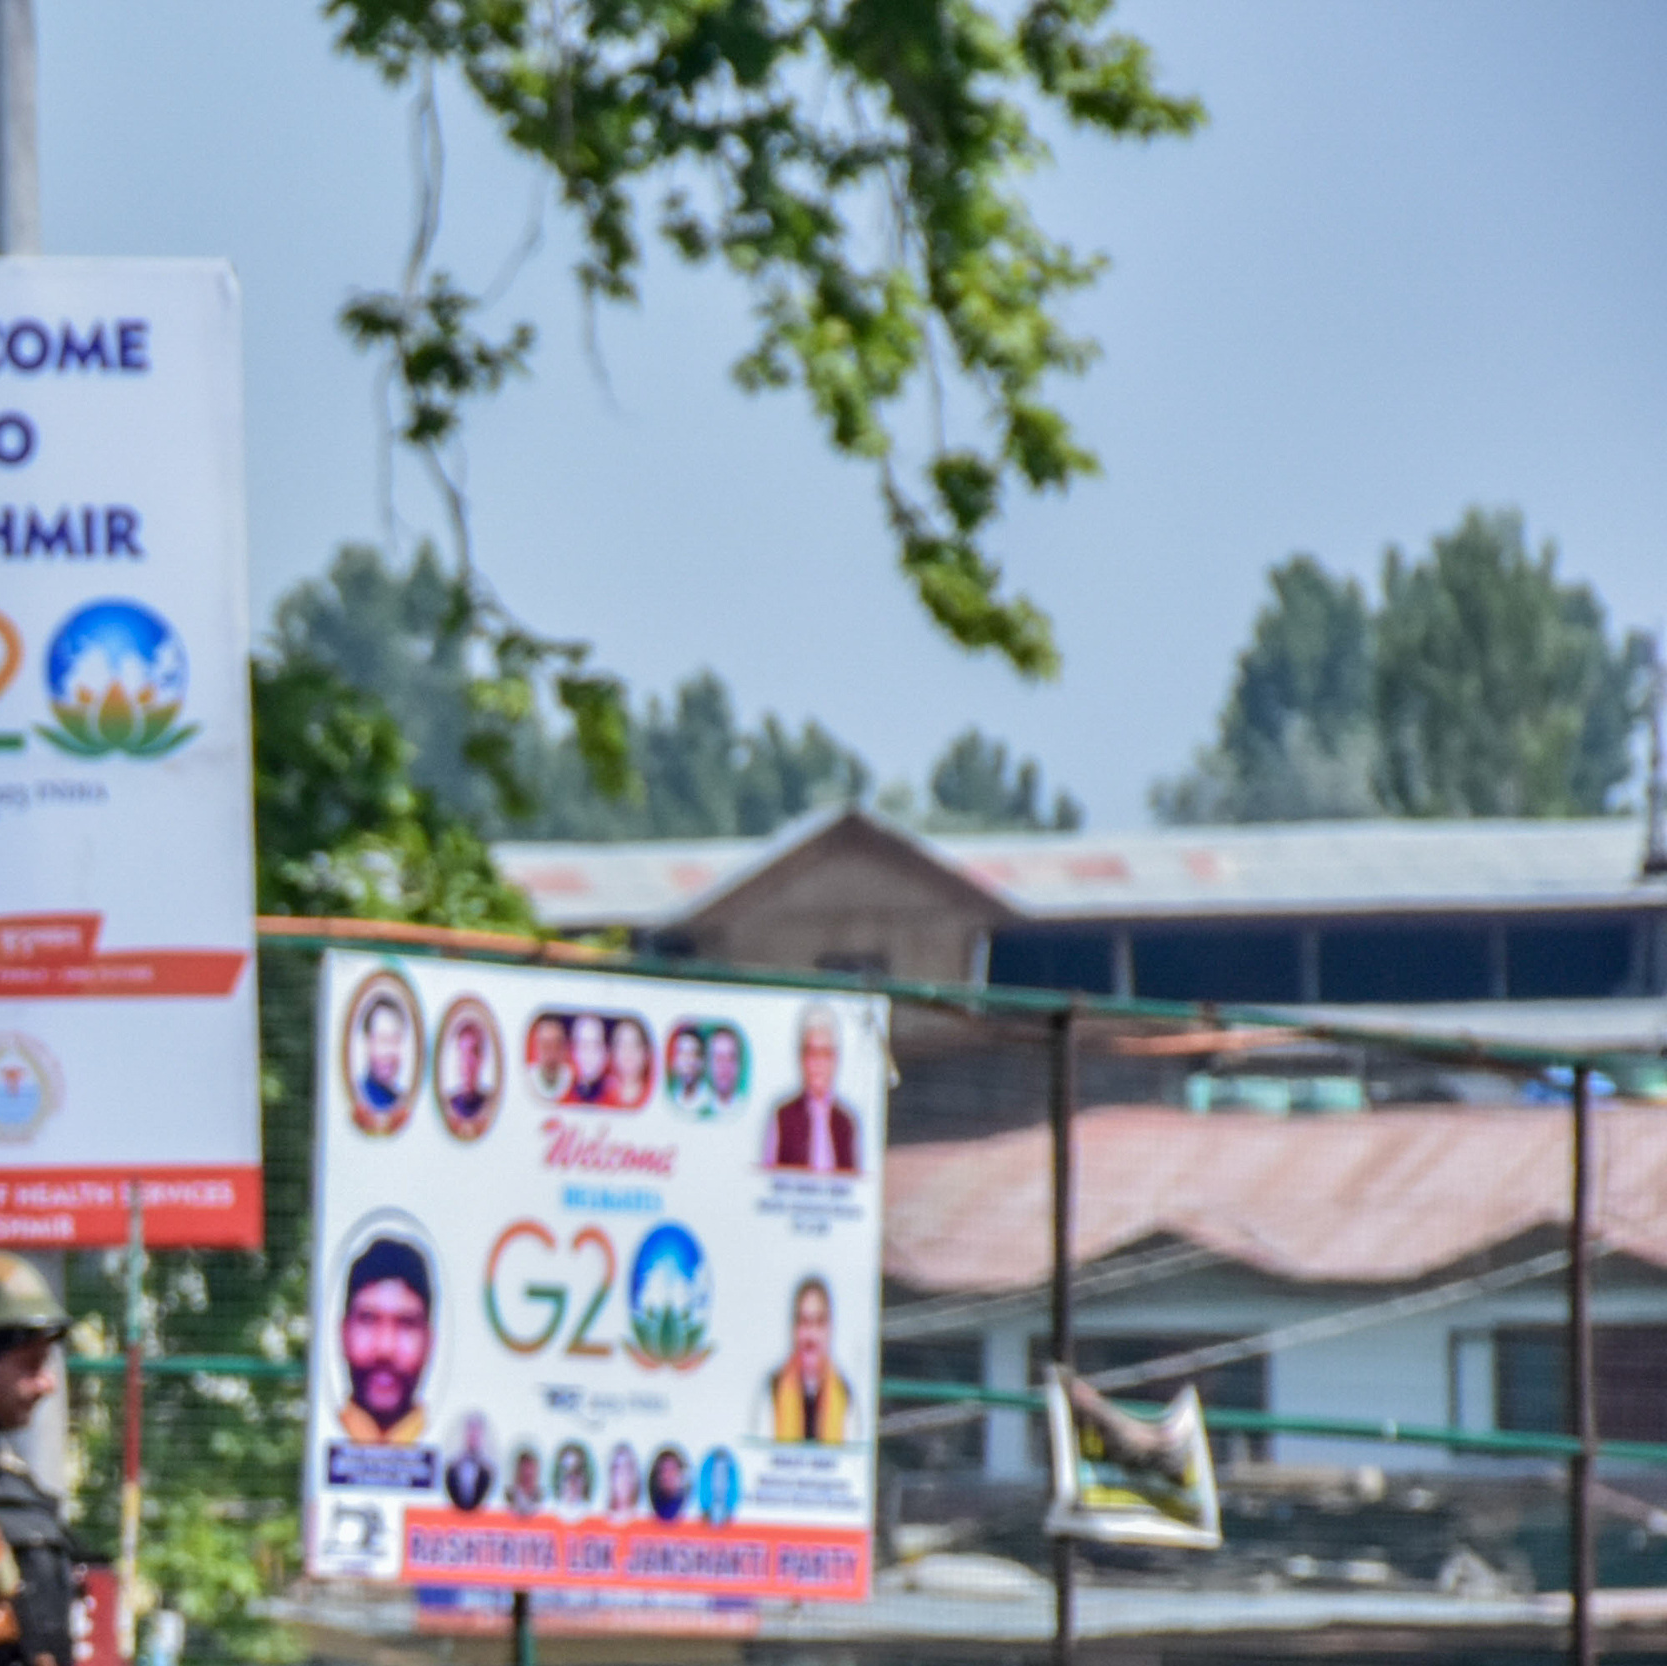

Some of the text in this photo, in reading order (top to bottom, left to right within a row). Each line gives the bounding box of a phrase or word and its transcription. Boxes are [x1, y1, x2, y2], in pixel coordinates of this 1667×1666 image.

[541, 1117, 678, 1179] Welcome
[15, 1181, 114, 1208] HEALTH
[483, 1217, 718, 1372] G20
[409, 1524, 860, 1586] RASHTRIYA LOK JANSHAKTI PARTY
